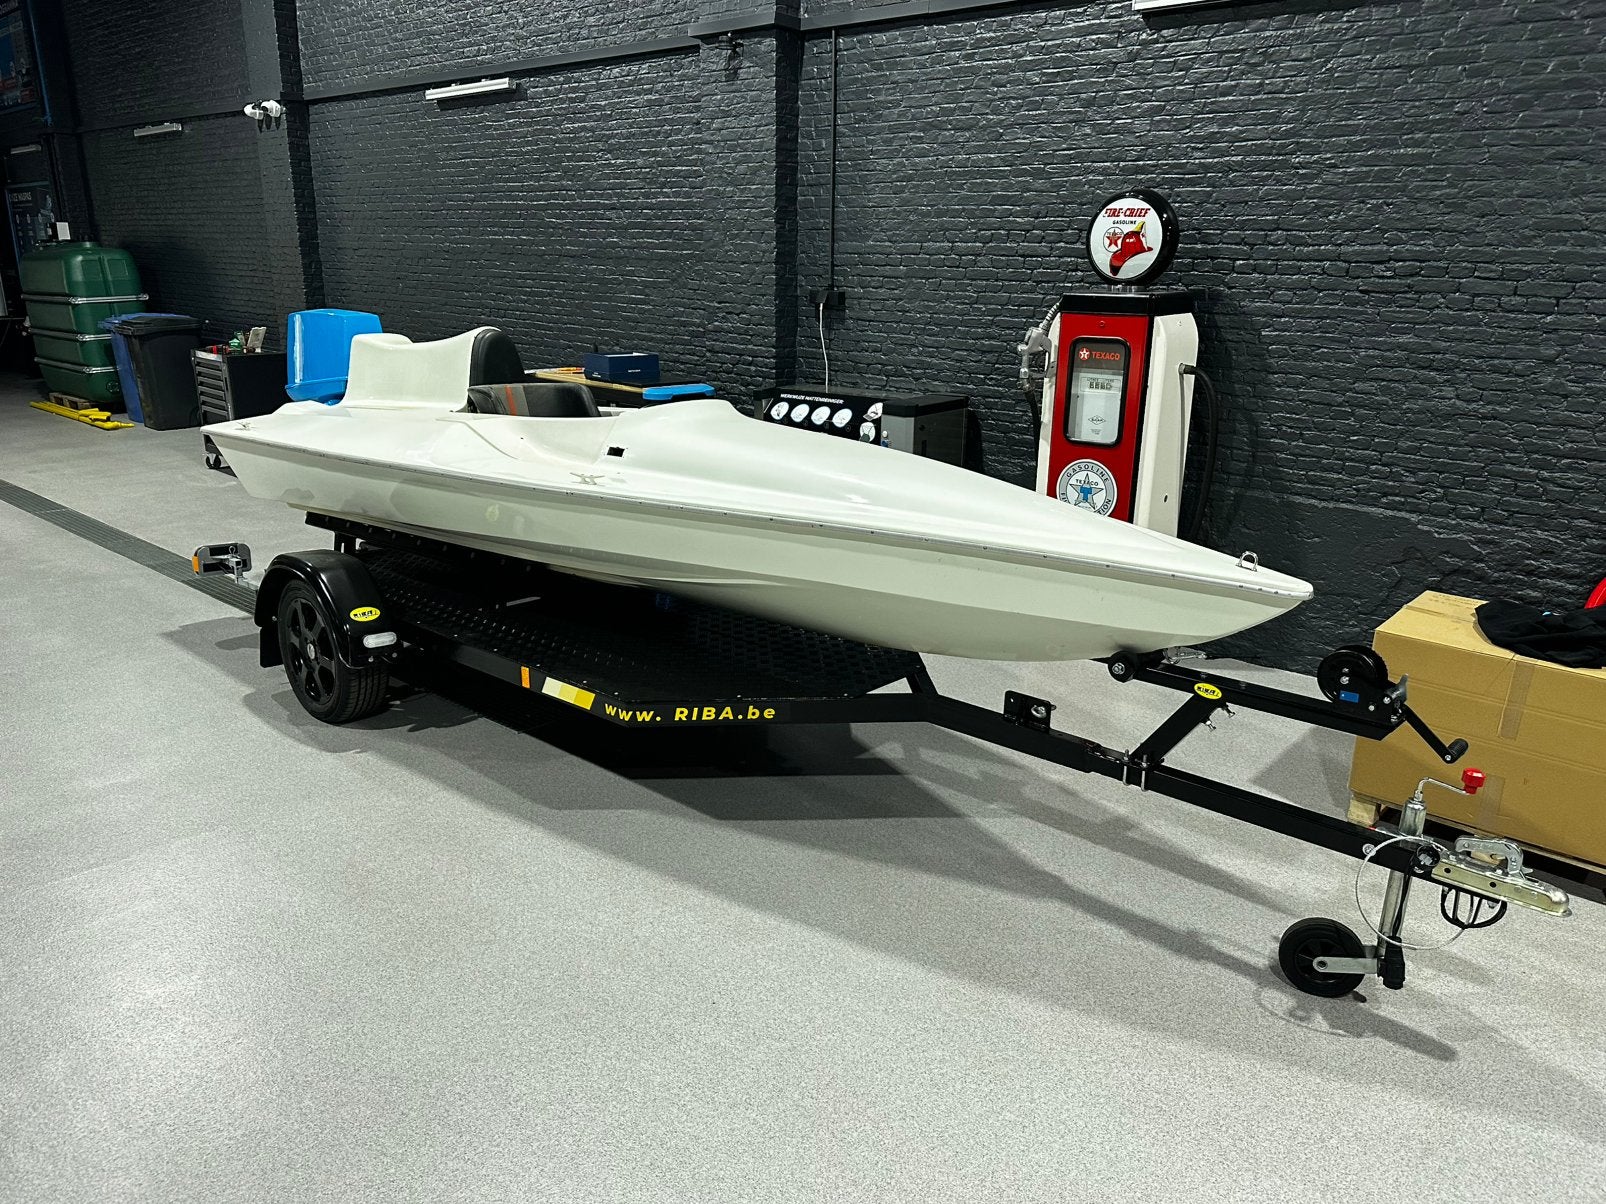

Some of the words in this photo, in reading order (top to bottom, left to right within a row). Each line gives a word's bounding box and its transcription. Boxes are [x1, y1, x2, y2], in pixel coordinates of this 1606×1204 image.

[1103, 208, 1151, 218] FIRE-CHIEF
[1091, 351, 1120, 361] TEXACO
[1066, 464, 1110, 482] GASOLINE
[604, 703, 662, 722] www.
[674, 705, 776, 721] RIBA.be
